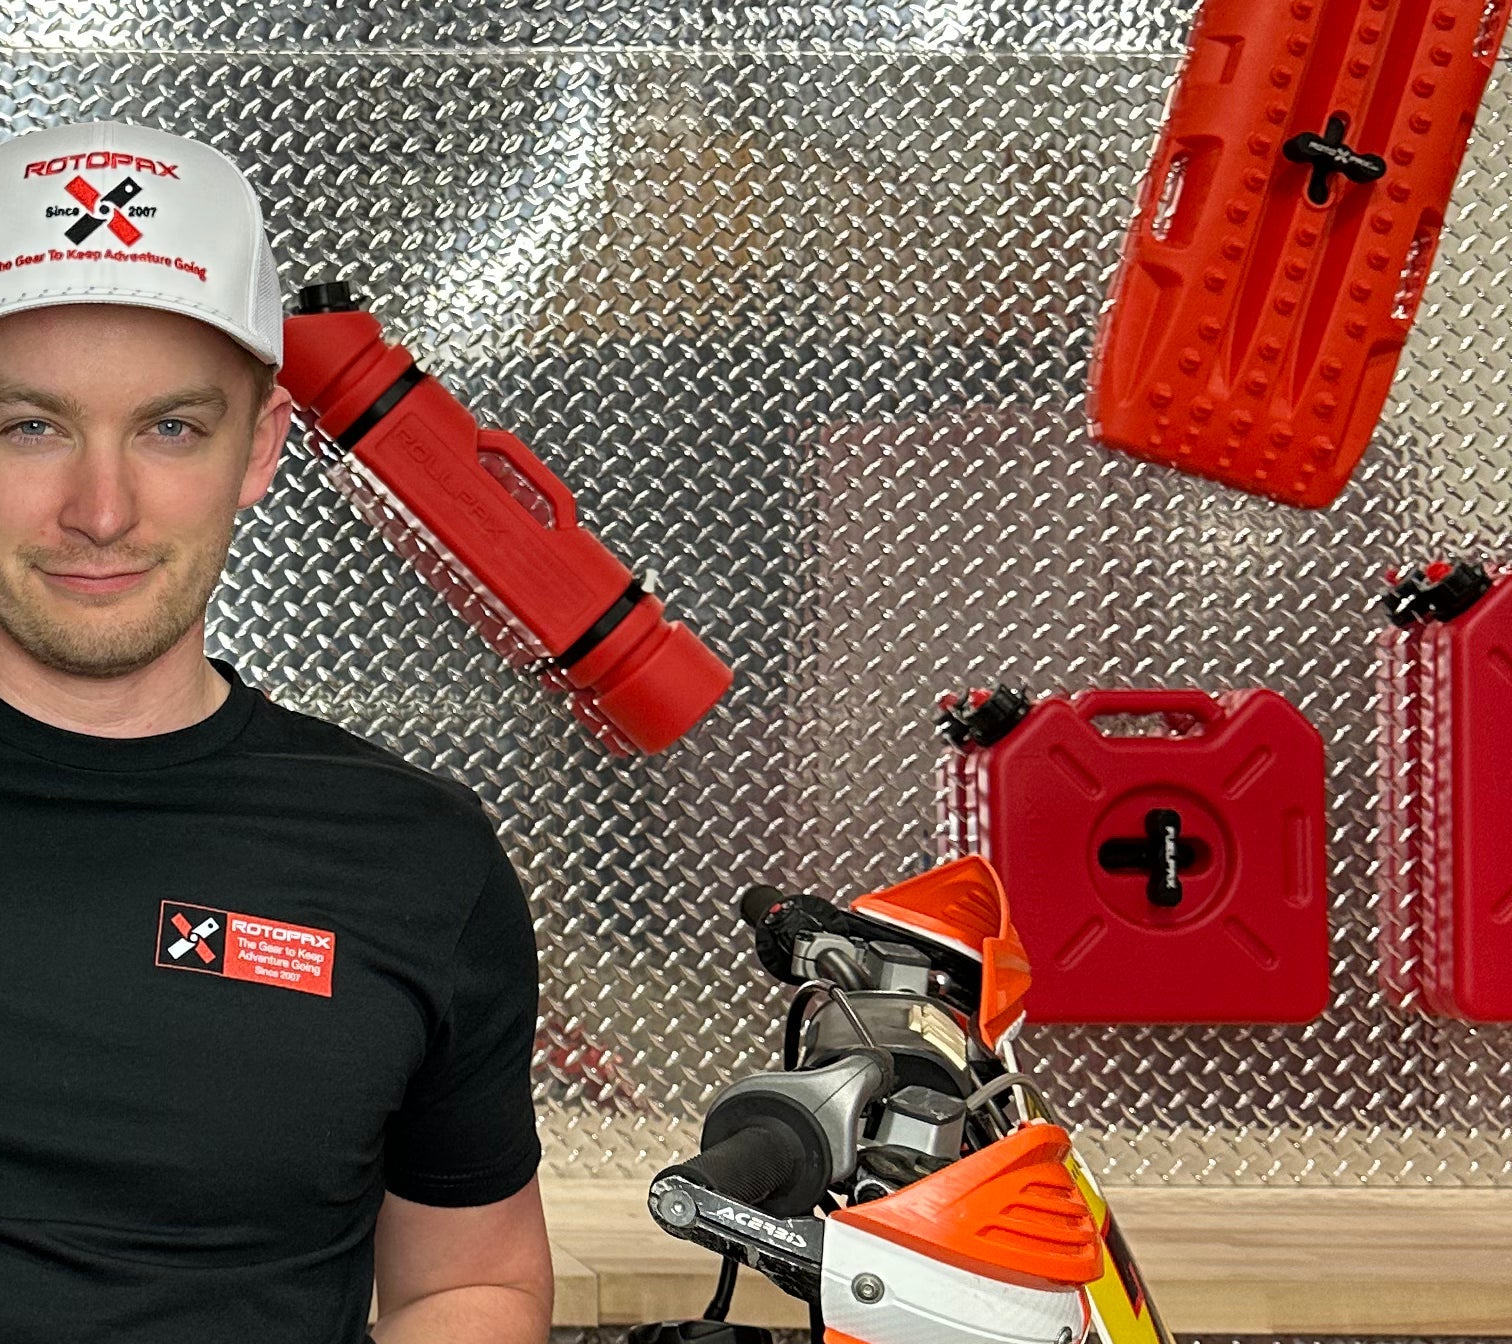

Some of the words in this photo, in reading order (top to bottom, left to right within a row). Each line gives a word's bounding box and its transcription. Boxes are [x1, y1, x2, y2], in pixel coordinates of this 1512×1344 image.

[24, 152, 180, 179] ROTOPAX
[46, 206, 79, 218] Since
[16, 252, 45, 266] Gear
[48, 249, 64, 261] To
[67, 249, 100, 262] Keep
[104, 249, 173, 267] Adventure
[174, 258, 207, 281] Going
[231, 919, 331, 949] ROTOPAX
[237, 938, 257, 951] The
[258, 941, 282, 955] Gear
[298, 948, 325, 963] Keep
[238, 950, 290, 968] Adventure
[291, 959, 322, 976] Going
[254, 966, 279, 978] Since
